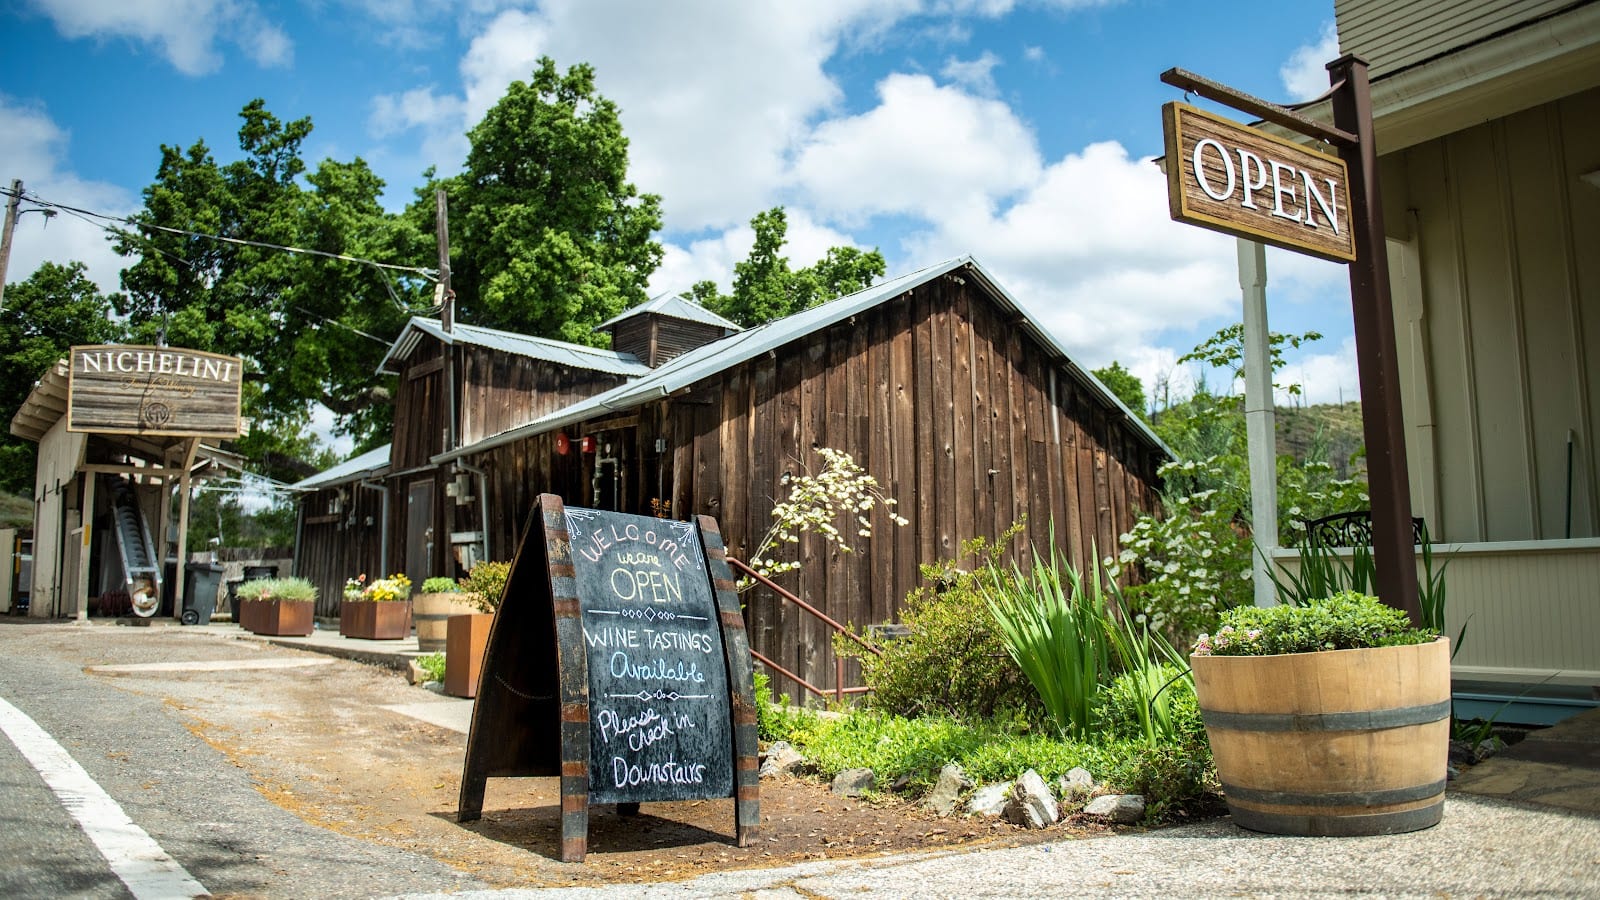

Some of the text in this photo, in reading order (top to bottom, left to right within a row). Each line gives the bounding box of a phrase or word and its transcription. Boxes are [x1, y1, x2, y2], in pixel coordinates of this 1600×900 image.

[1193, 138, 1339, 235] OPEN
[82, 352, 233, 382] NICHELINI
[611, 568, 682, 603] OPEN
[583, 627, 712, 653] WINE TASTINGS
[611, 651, 705, 683] Available
[598, 708, 660, 743] Please
[673, 711, 695, 729] in
[613, 753, 706, 788] Downstairs
